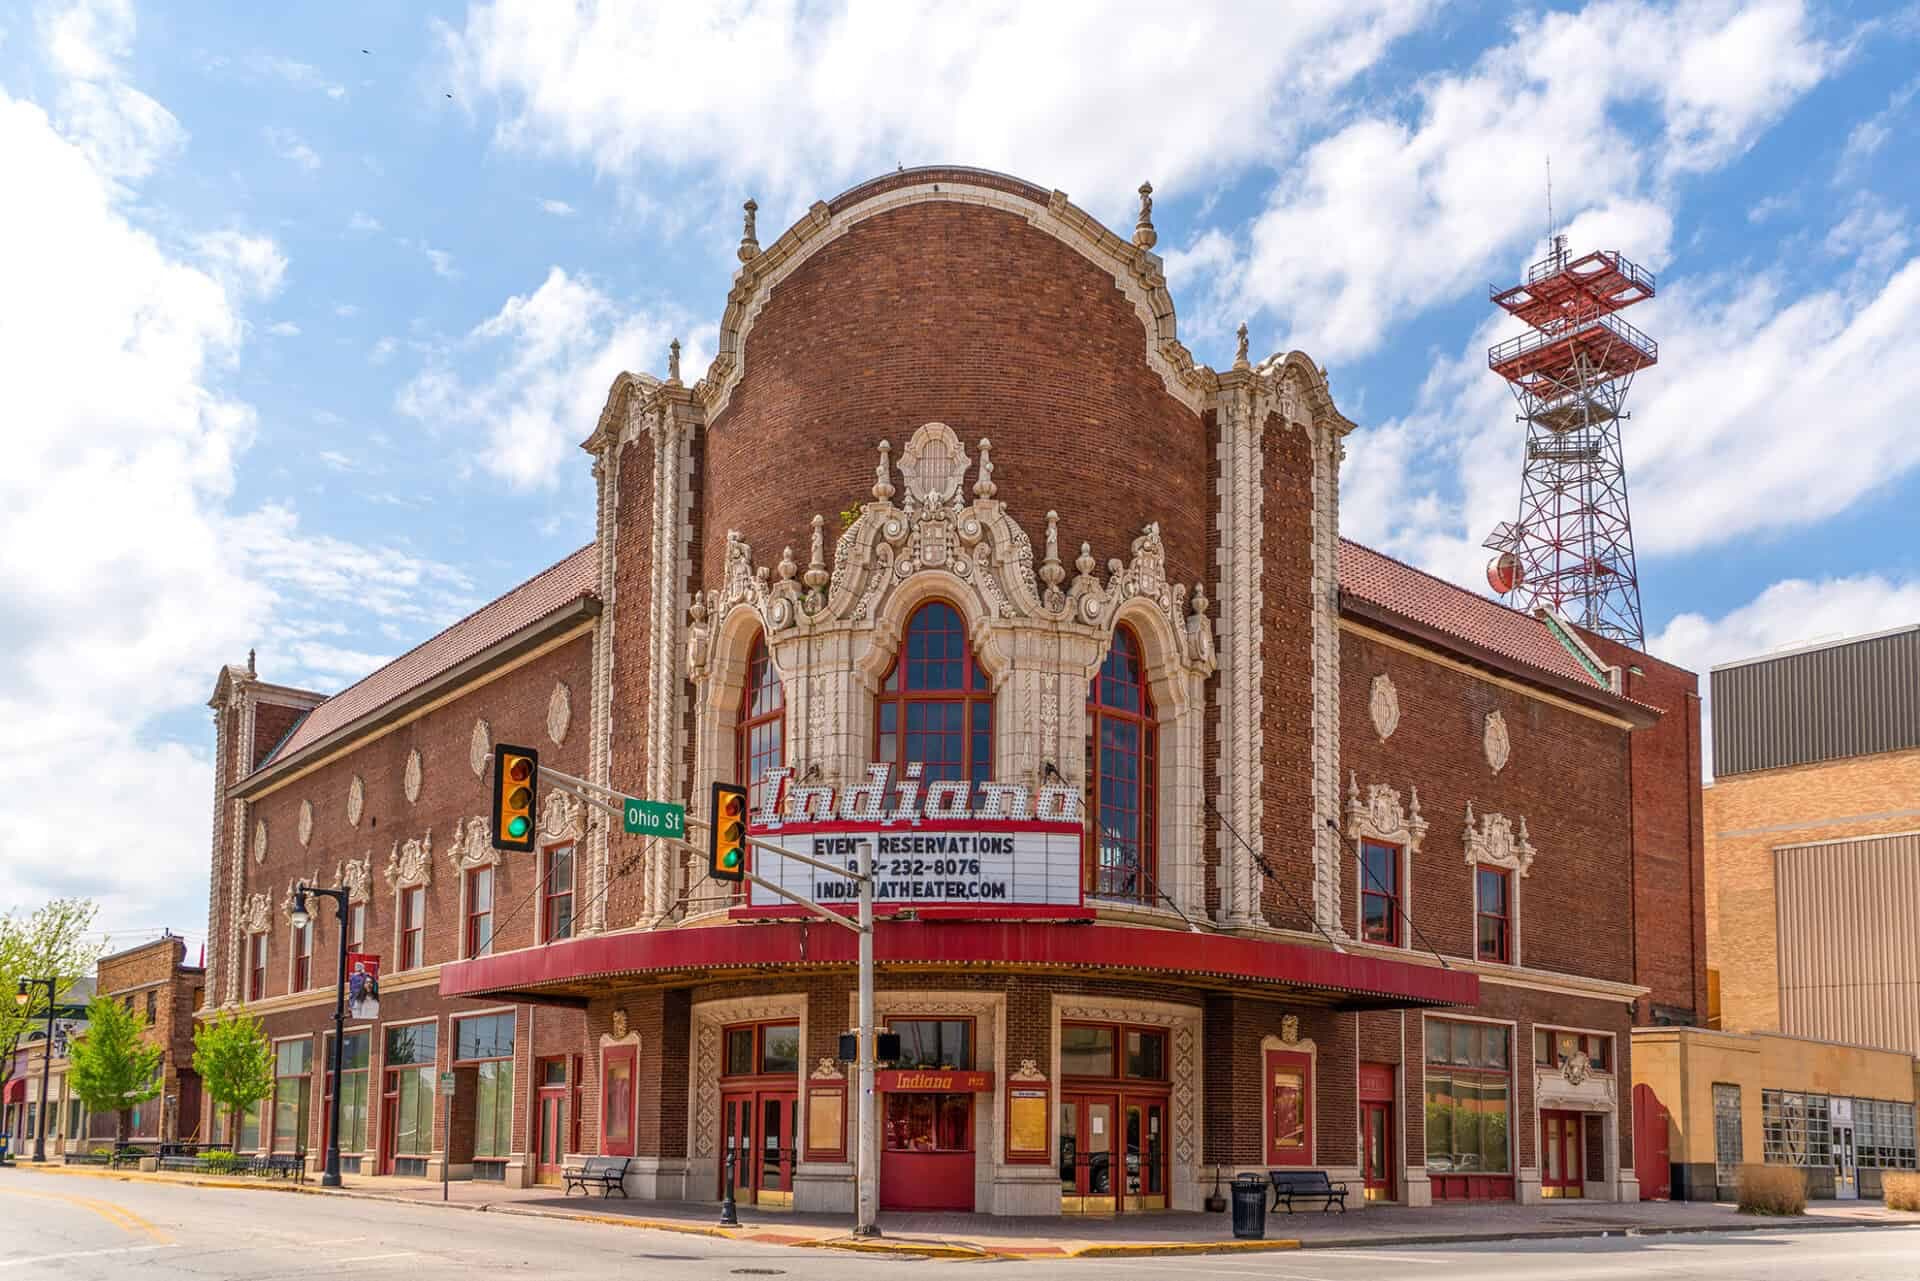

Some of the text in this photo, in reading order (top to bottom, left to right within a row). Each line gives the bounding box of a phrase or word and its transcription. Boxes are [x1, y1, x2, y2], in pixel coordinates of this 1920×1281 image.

[750, 762, 1084, 829] Indiana
[629, 808, 680, 830] Ohio St
[879, 837, 1014, 855] RESERVATIONS
[848, 859, 980, 876] 82-232-8076
[896, 1073, 953, 1089] Indiana
